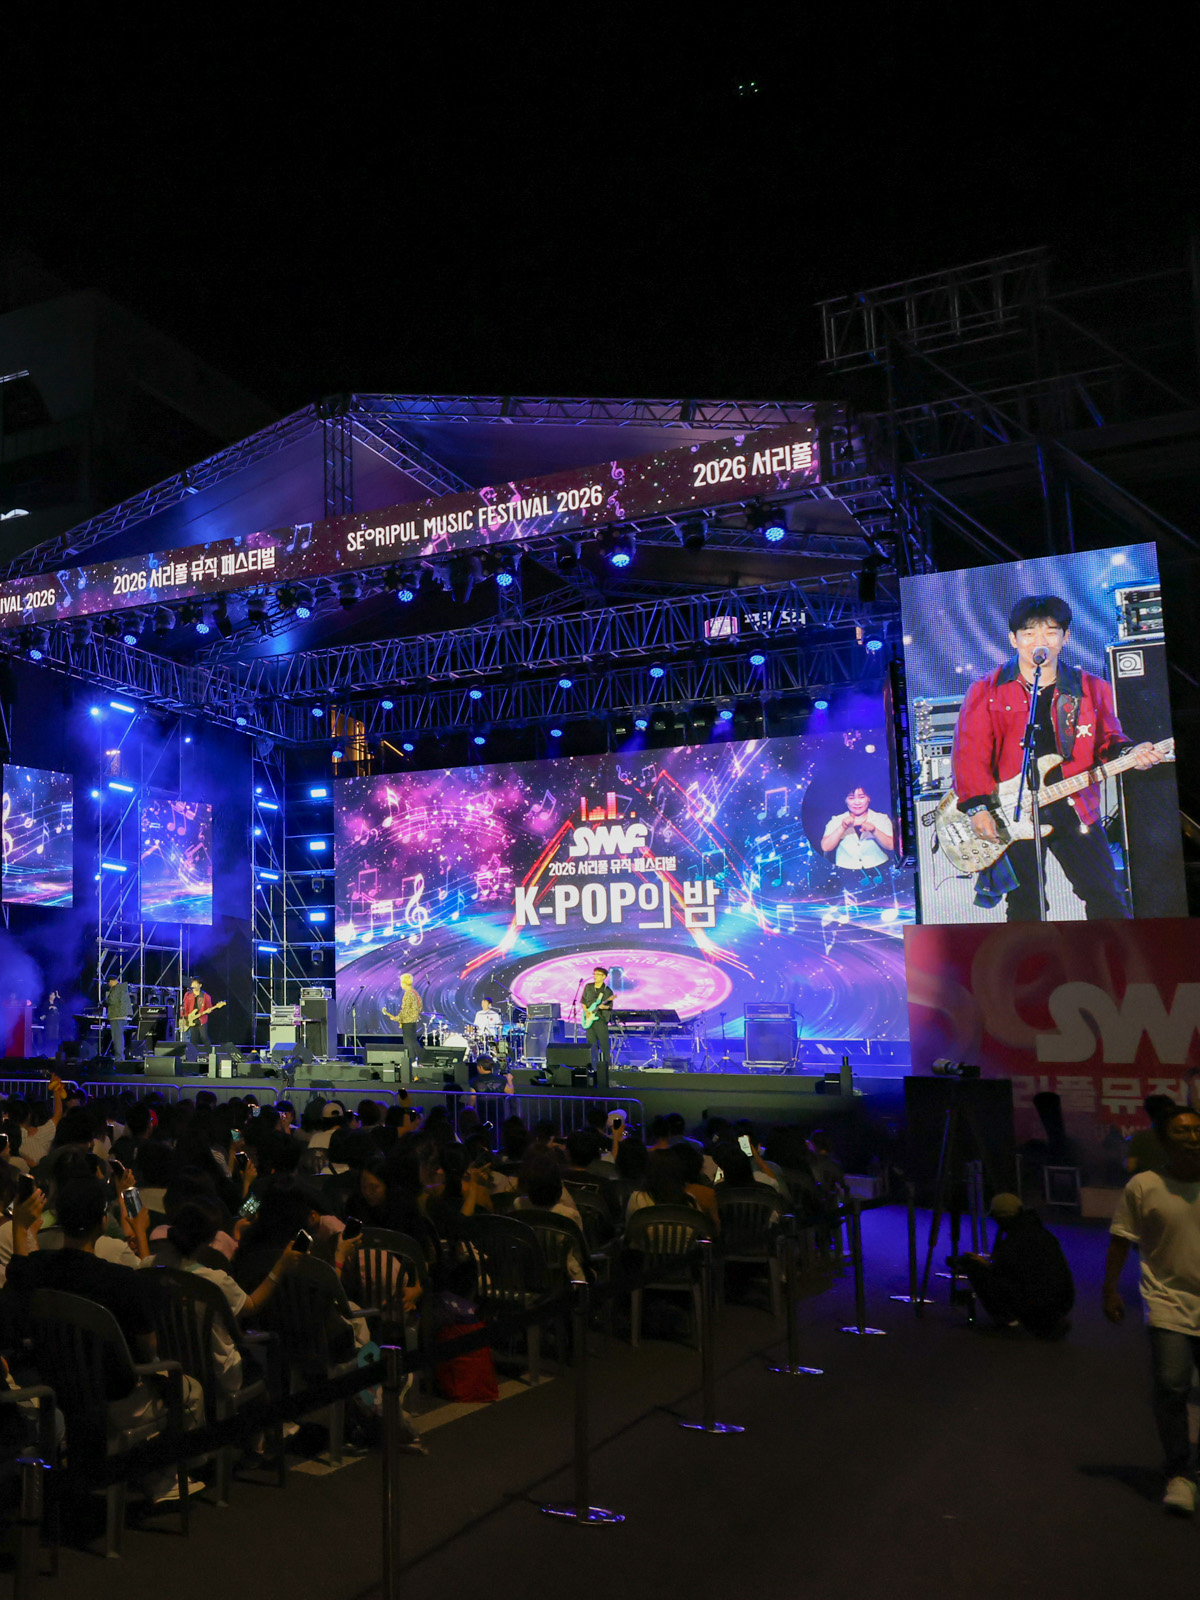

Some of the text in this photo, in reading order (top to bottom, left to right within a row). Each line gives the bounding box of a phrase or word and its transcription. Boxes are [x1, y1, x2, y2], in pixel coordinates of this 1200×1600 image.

[693, 441, 813, 487] 2026 서리풀
[423, 510, 474, 538] MUSIC
[478, 495, 553, 527] FESTIVAL
[557, 485, 603, 513] 2026
[113, 546, 276, 595] 2026 서리풀 뮤직 페스티벌
[25, 589, 56, 609] 2026
[548, 856, 677, 876] 2026 서리풀 뮤직 페스티벌
[514, 879, 720, 929] K-POP의 밤
